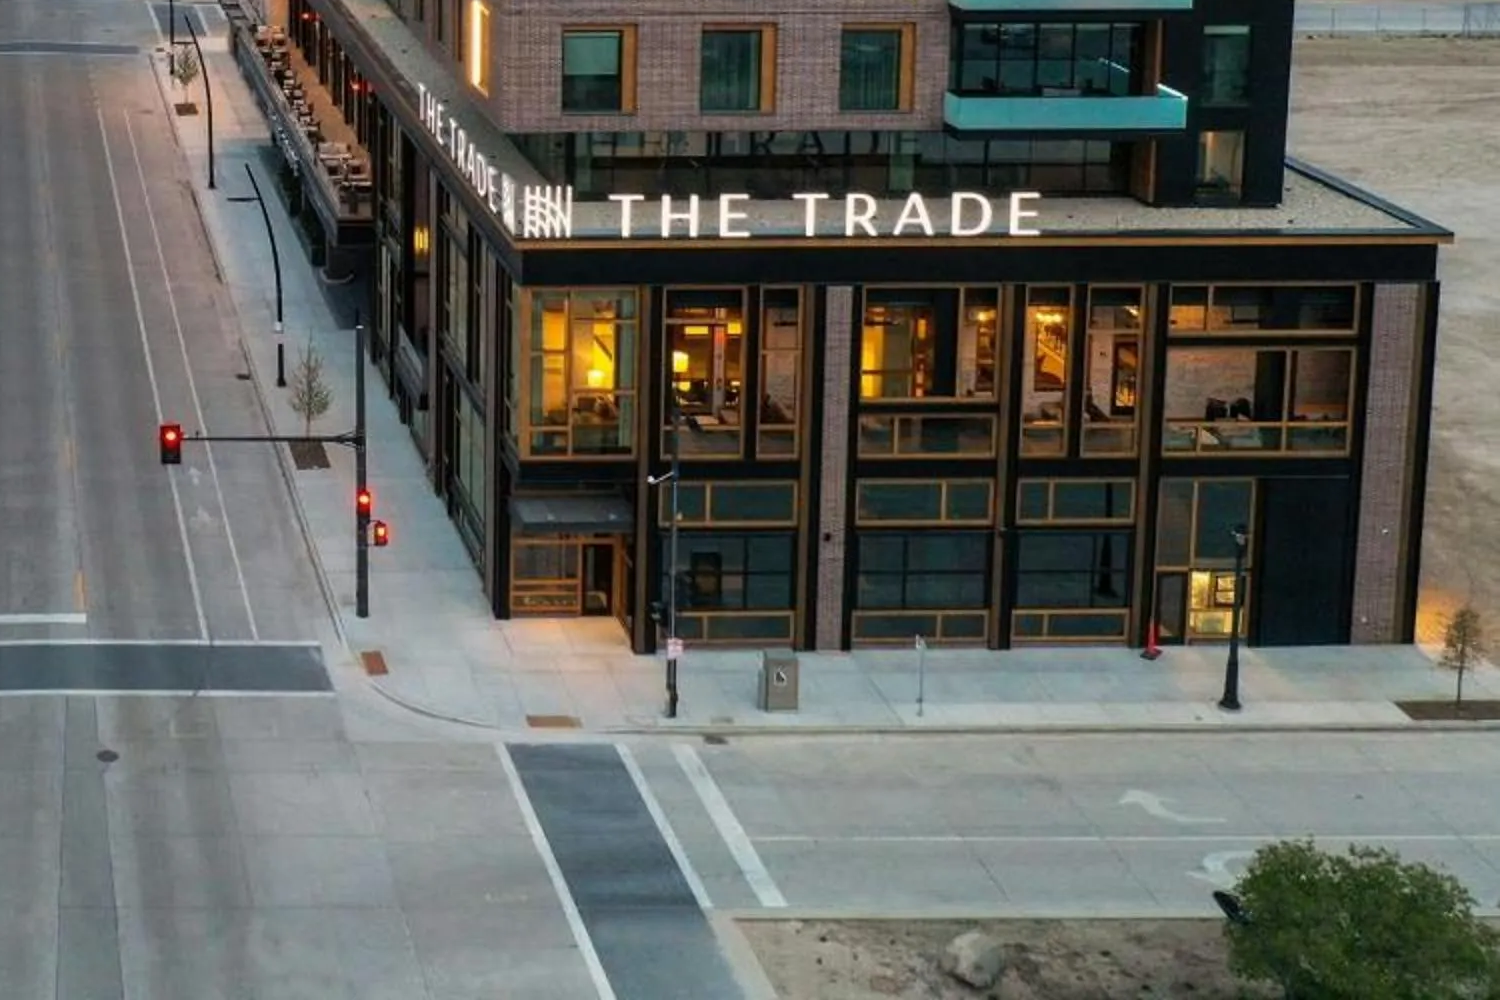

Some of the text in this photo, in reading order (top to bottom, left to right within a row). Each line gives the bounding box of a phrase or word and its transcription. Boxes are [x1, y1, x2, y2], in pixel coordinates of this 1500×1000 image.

[418, 83, 499, 214] THE TRADE
[608, 191, 1041, 238] THE TRADE
